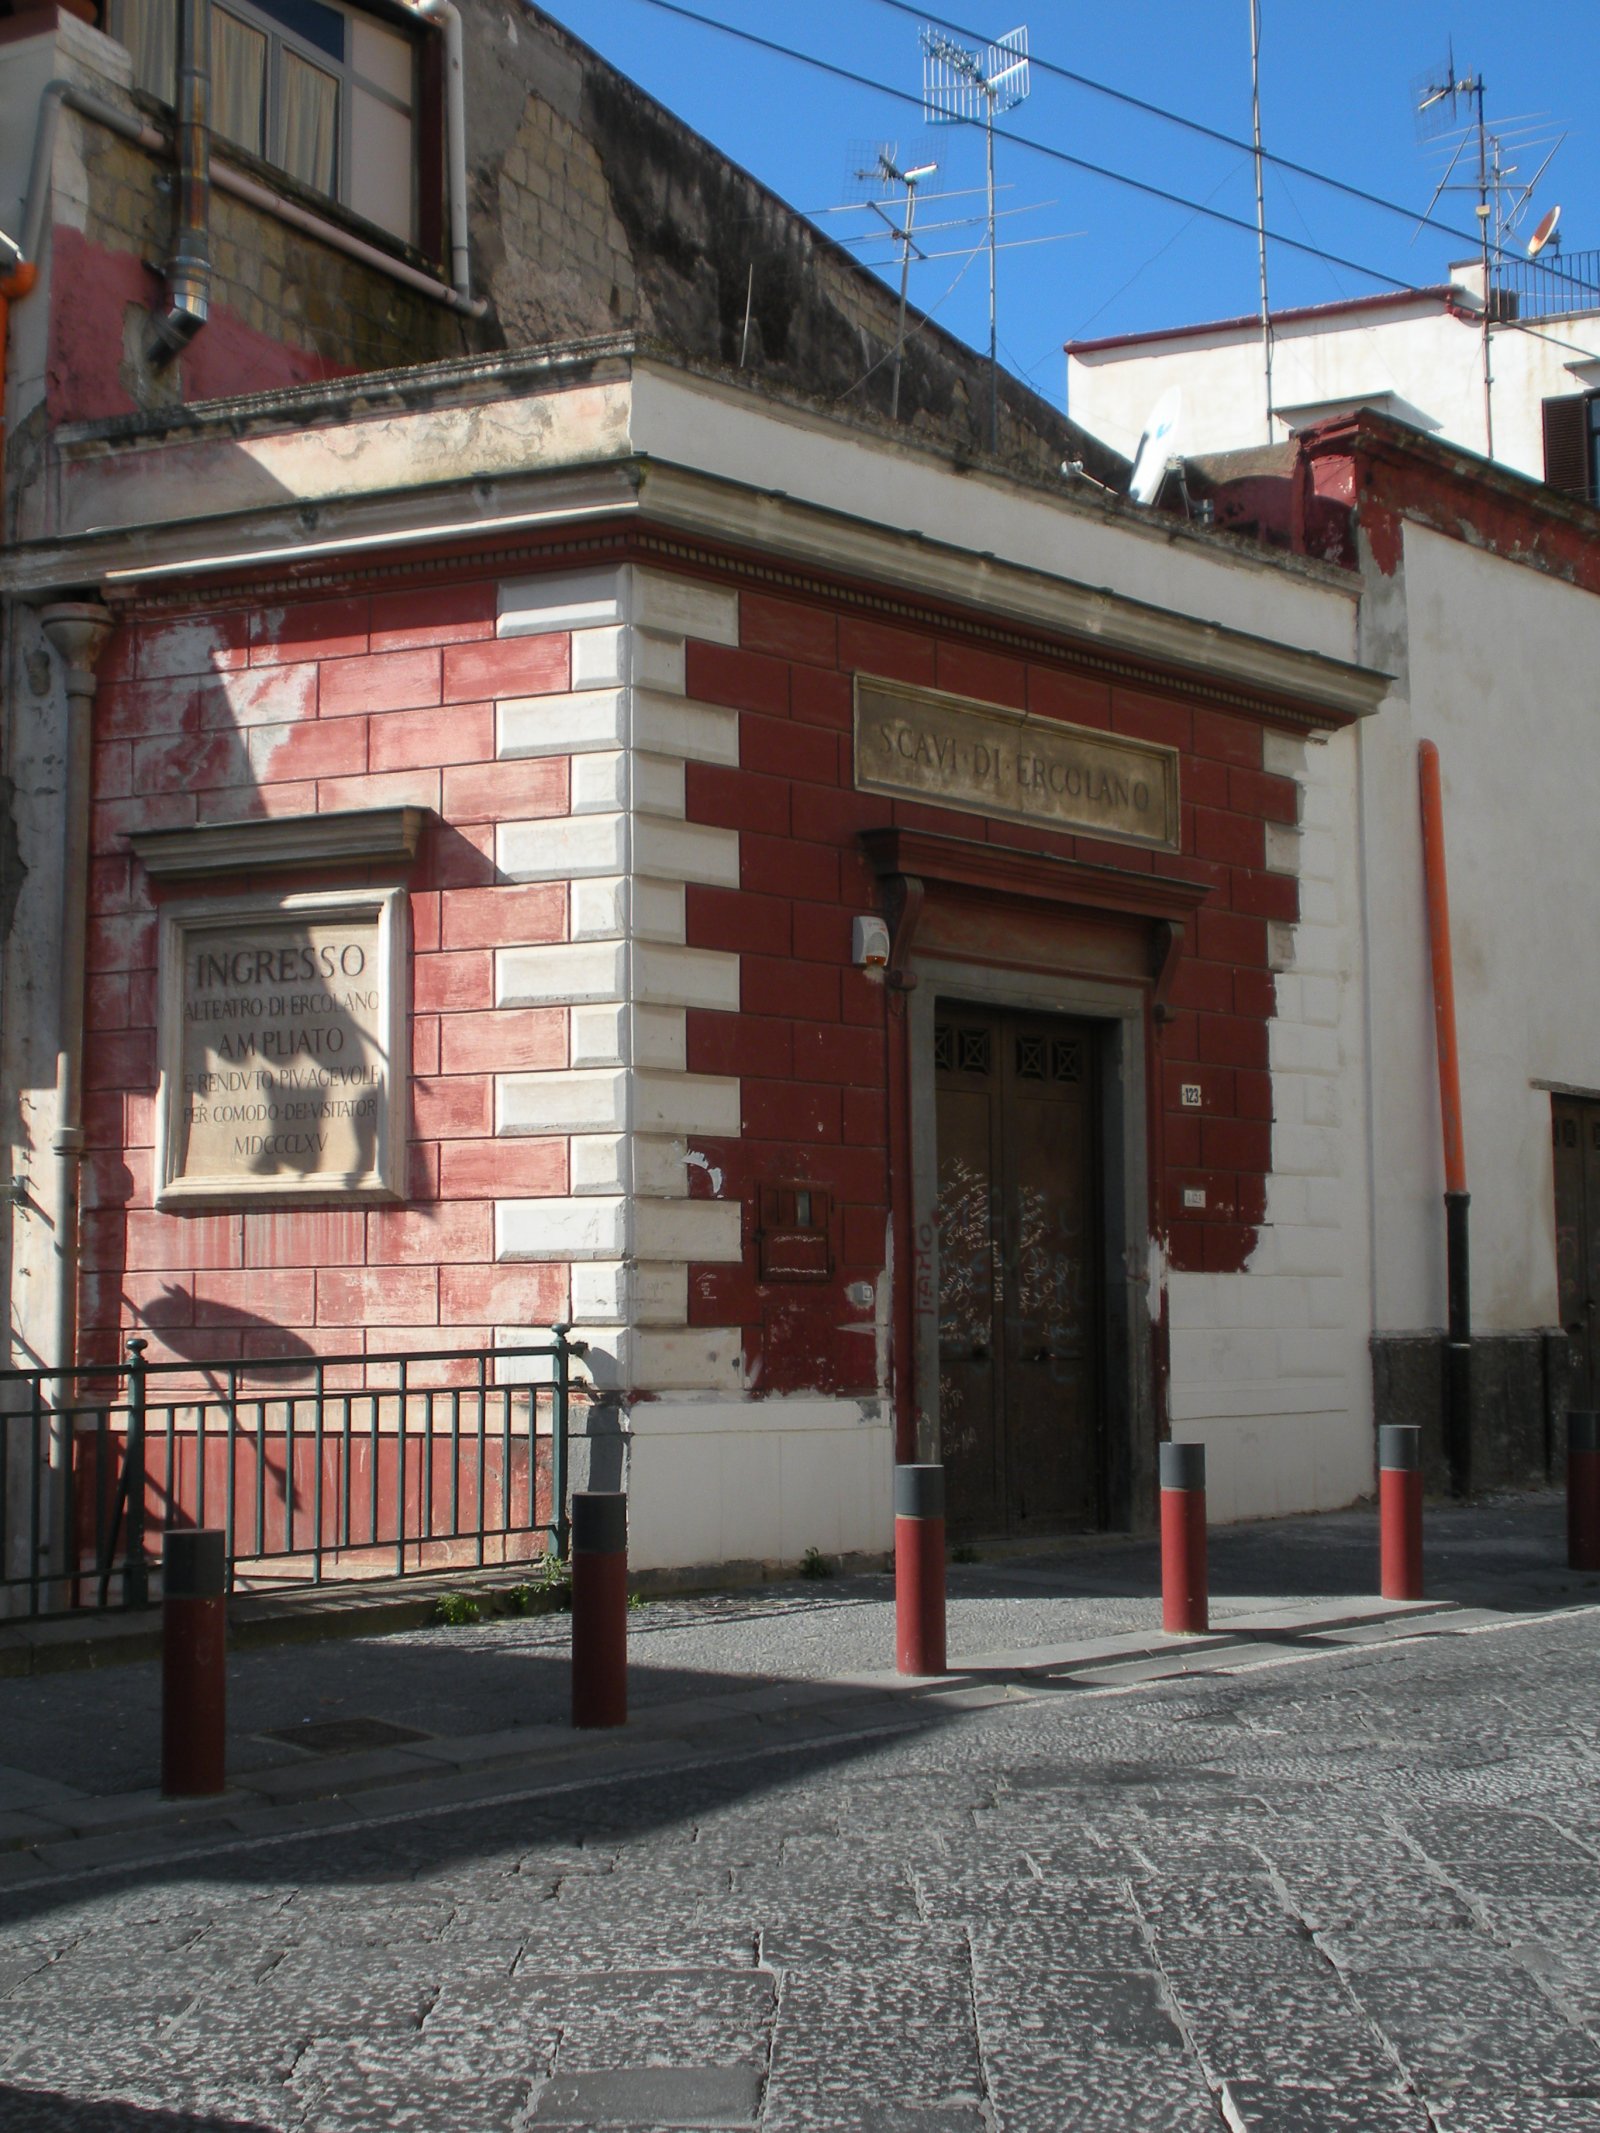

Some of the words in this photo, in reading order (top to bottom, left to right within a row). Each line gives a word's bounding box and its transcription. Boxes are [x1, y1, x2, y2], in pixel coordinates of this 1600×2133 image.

[880, 722, 957, 775] SCAVI
[974, 743, 1000, 781] DI
[1015, 752, 1150, 812] ERCOLANO
[196, 944, 366, 989] INGRESSO
[269, 995, 286, 1017] DI
[291, 990, 379, 1016] ERCOLANO
[217, 1027, 345, 1058] AMPLIATO
[1185, 1087, 1199, 1104] 123
[183, 1102, 207, 1124] PER
[213, 1102, 279, 1124] COMODO
